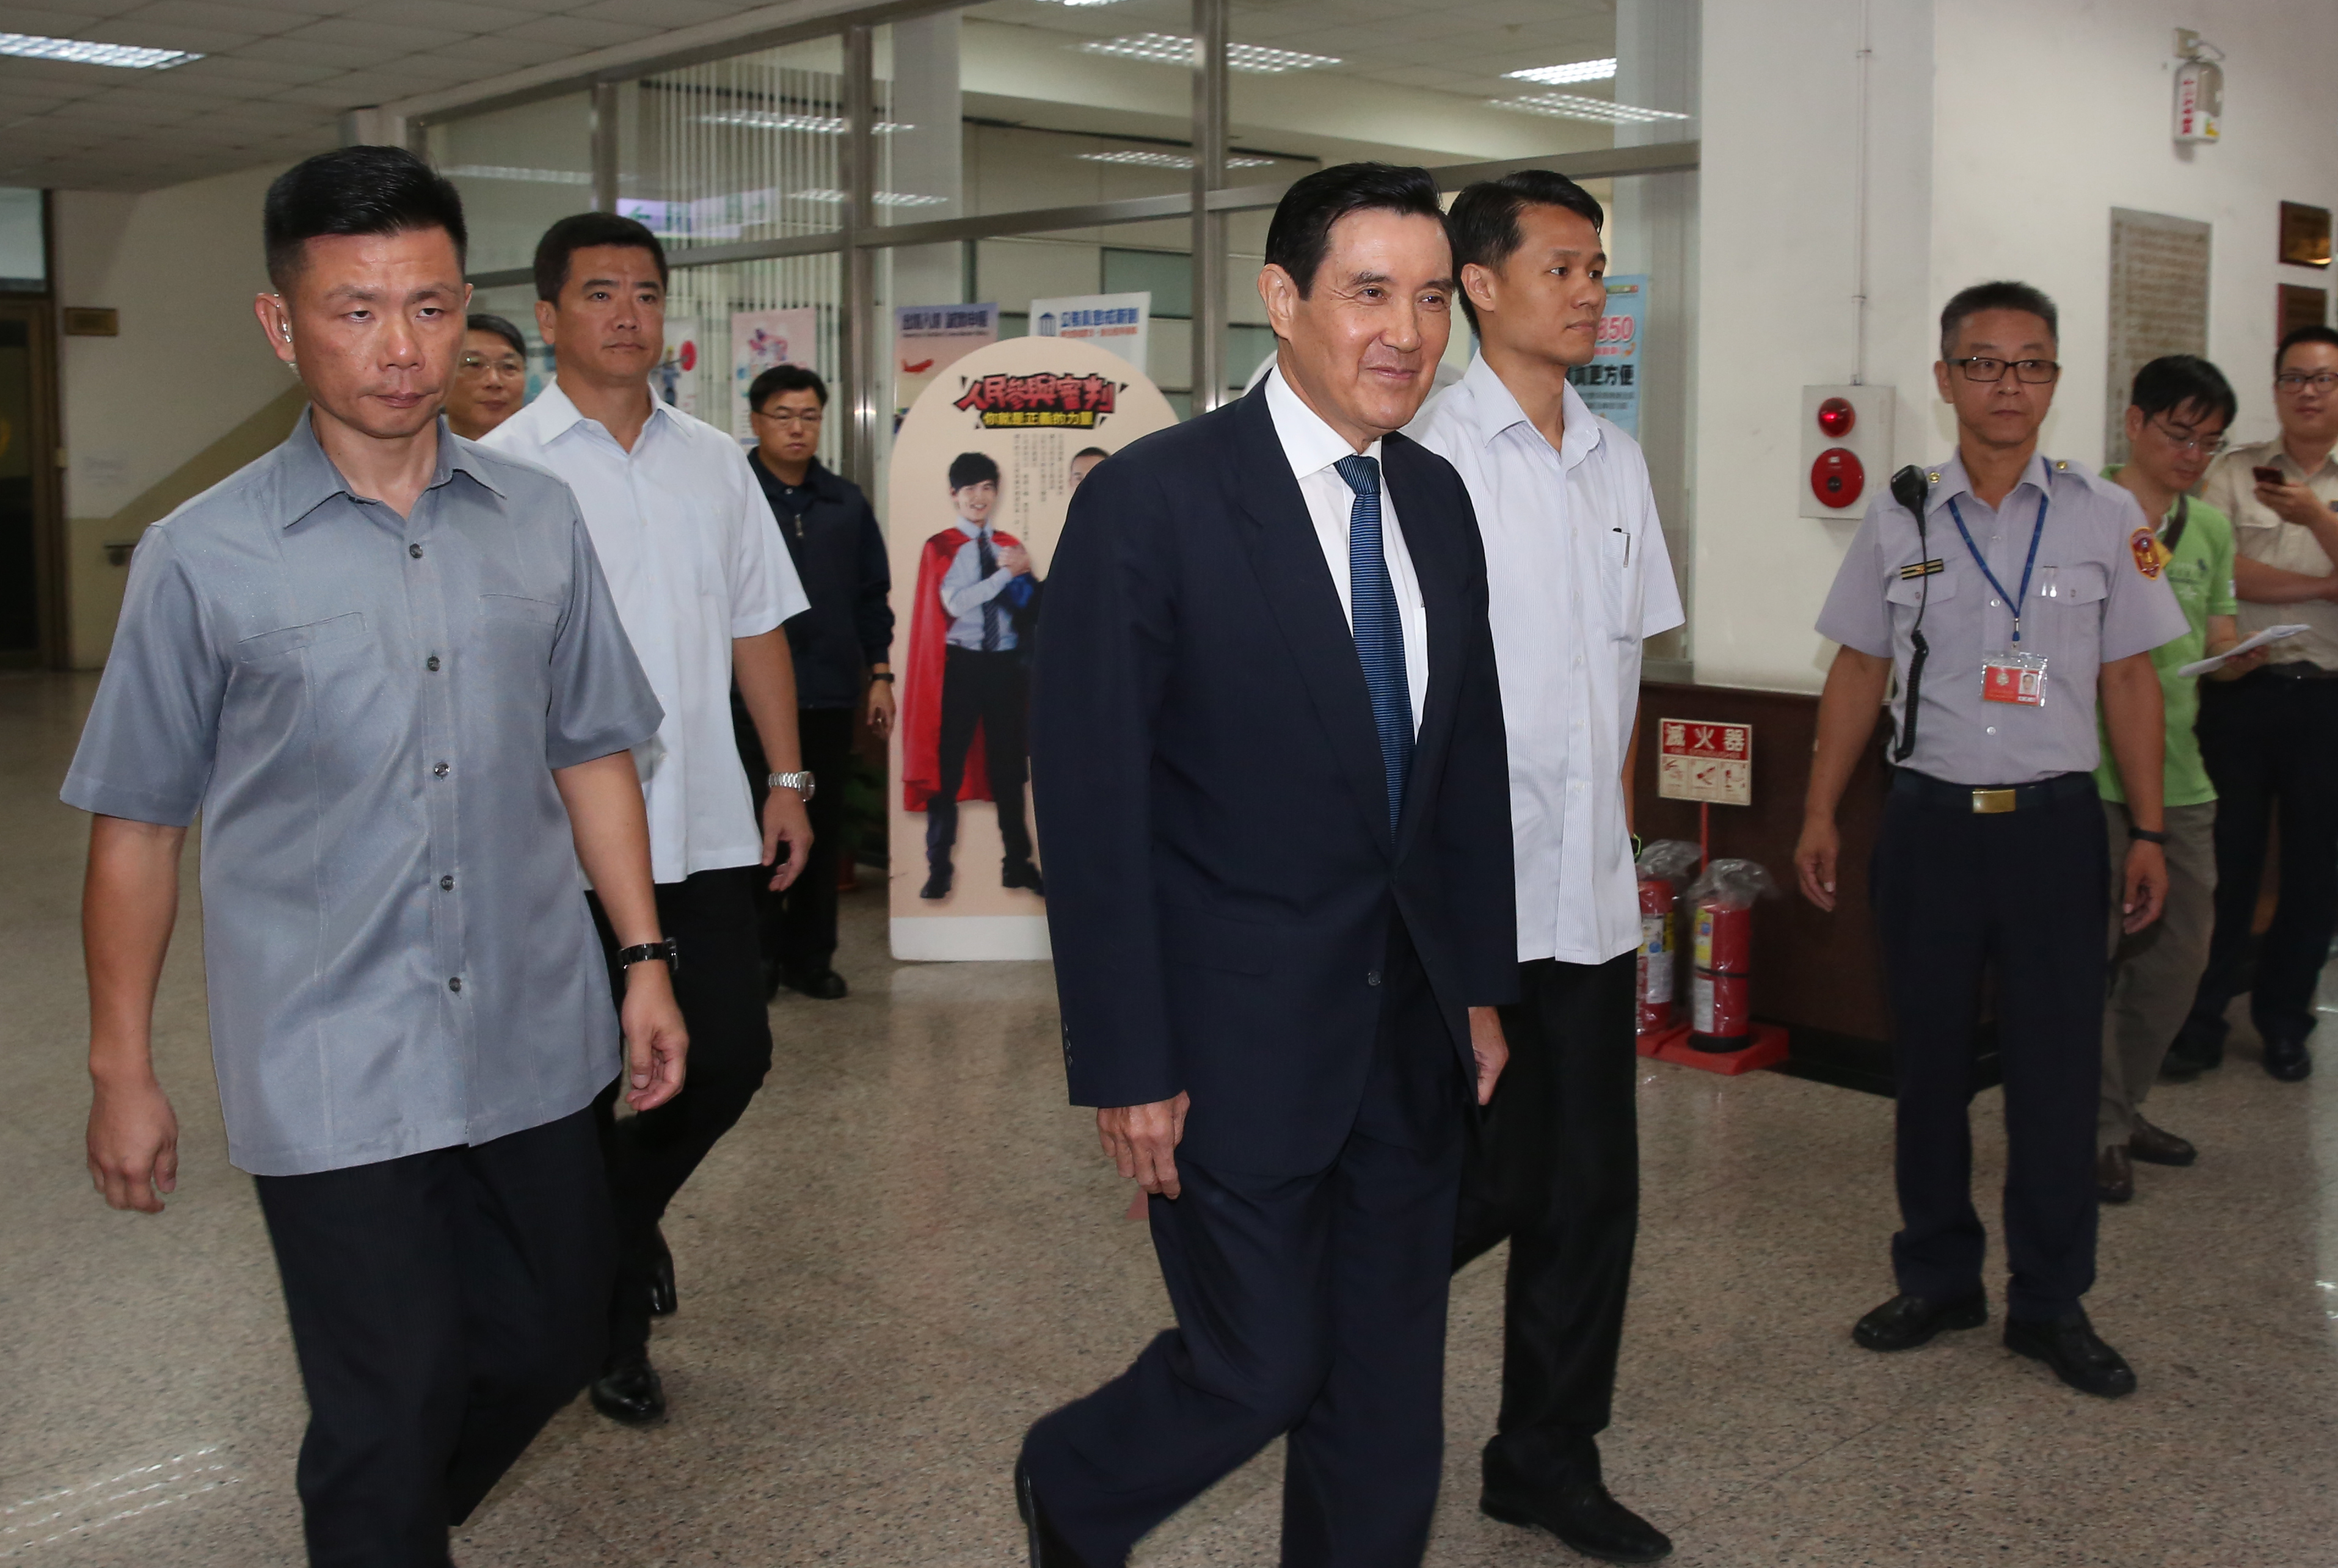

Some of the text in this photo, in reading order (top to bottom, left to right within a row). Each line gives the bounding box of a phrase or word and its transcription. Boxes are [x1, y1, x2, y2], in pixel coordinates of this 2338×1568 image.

[953, 372, 1116, 413] 人民參與審判
[982, 412, 1094, 426] 你就是正義的力量
[1664, 723, 1745, 752] 滅火器
